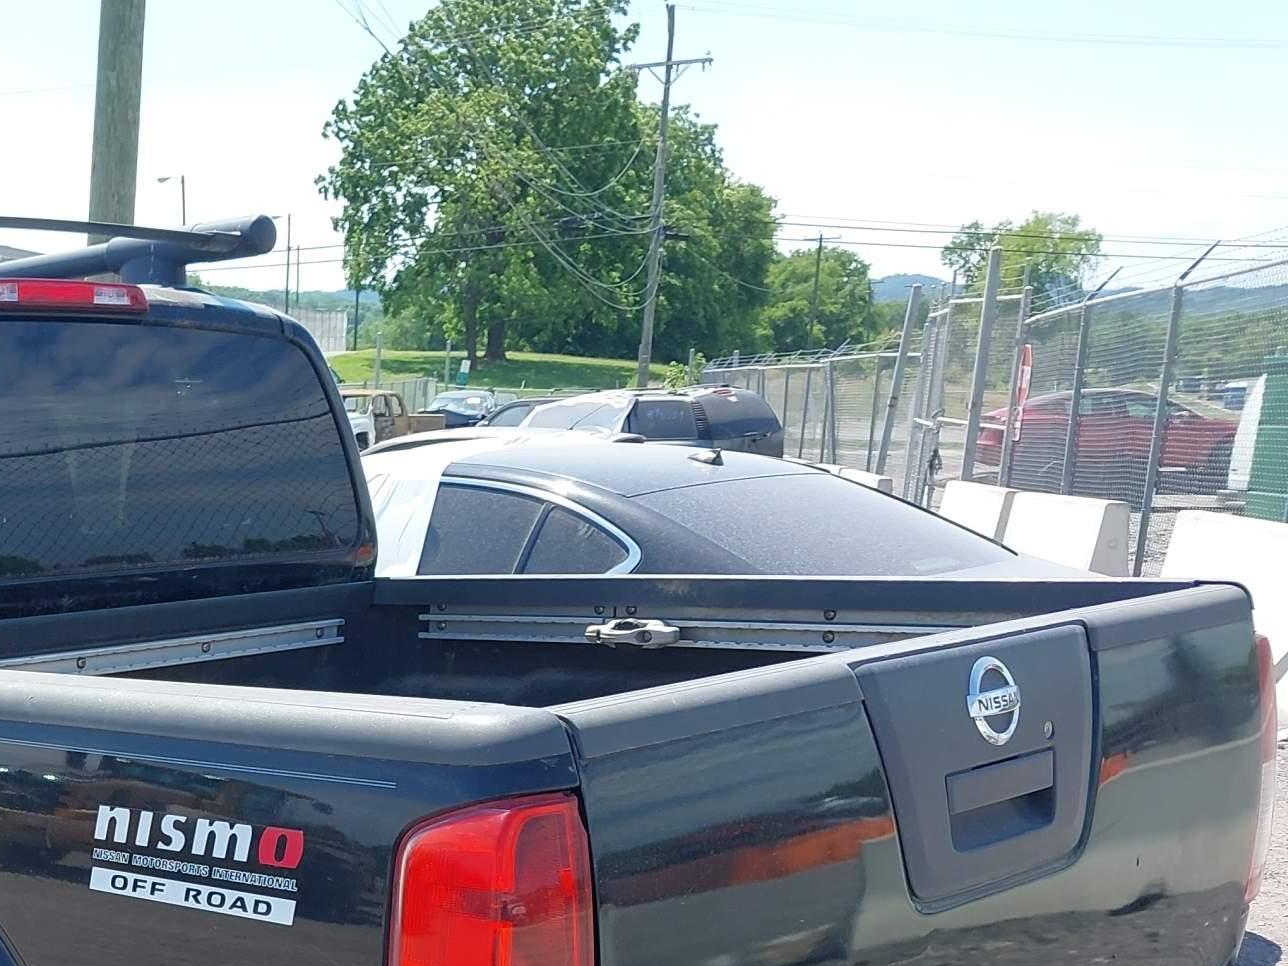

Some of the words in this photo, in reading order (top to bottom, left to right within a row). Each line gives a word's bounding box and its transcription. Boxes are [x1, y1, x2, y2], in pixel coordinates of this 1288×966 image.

[93, 847, 129, 864] NISSAN
[131, 854, 209, 878] MOTORSPORTS
[212, 867, 298, 892] INTERNATIONAL
[111, 874, 166, 896] OFF
[184, 887, 272, 917] ROAD
